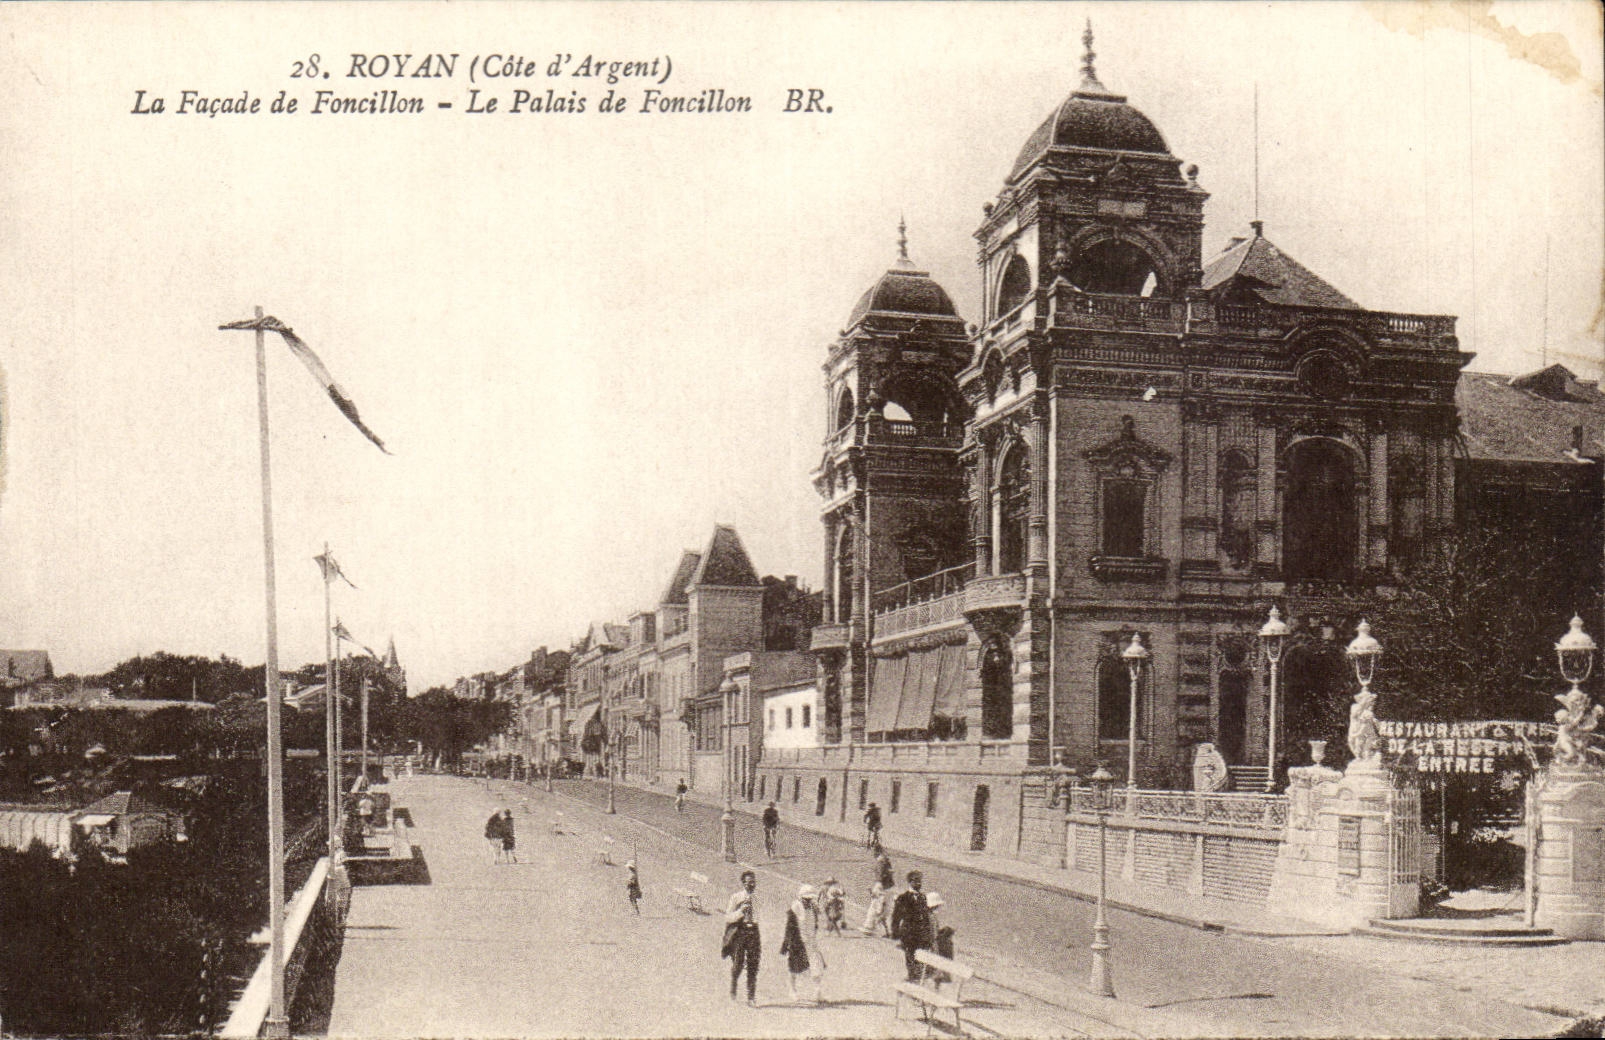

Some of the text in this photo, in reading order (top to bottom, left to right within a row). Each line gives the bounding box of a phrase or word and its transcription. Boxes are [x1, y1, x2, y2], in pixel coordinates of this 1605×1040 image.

[1379, 720, 1486, 738] RESTAURANT
[1387, 738, 1407, 754] DE
[1412, 739, 1435, 755] LA
[1417, 755, 1495, 773] ENTREE
